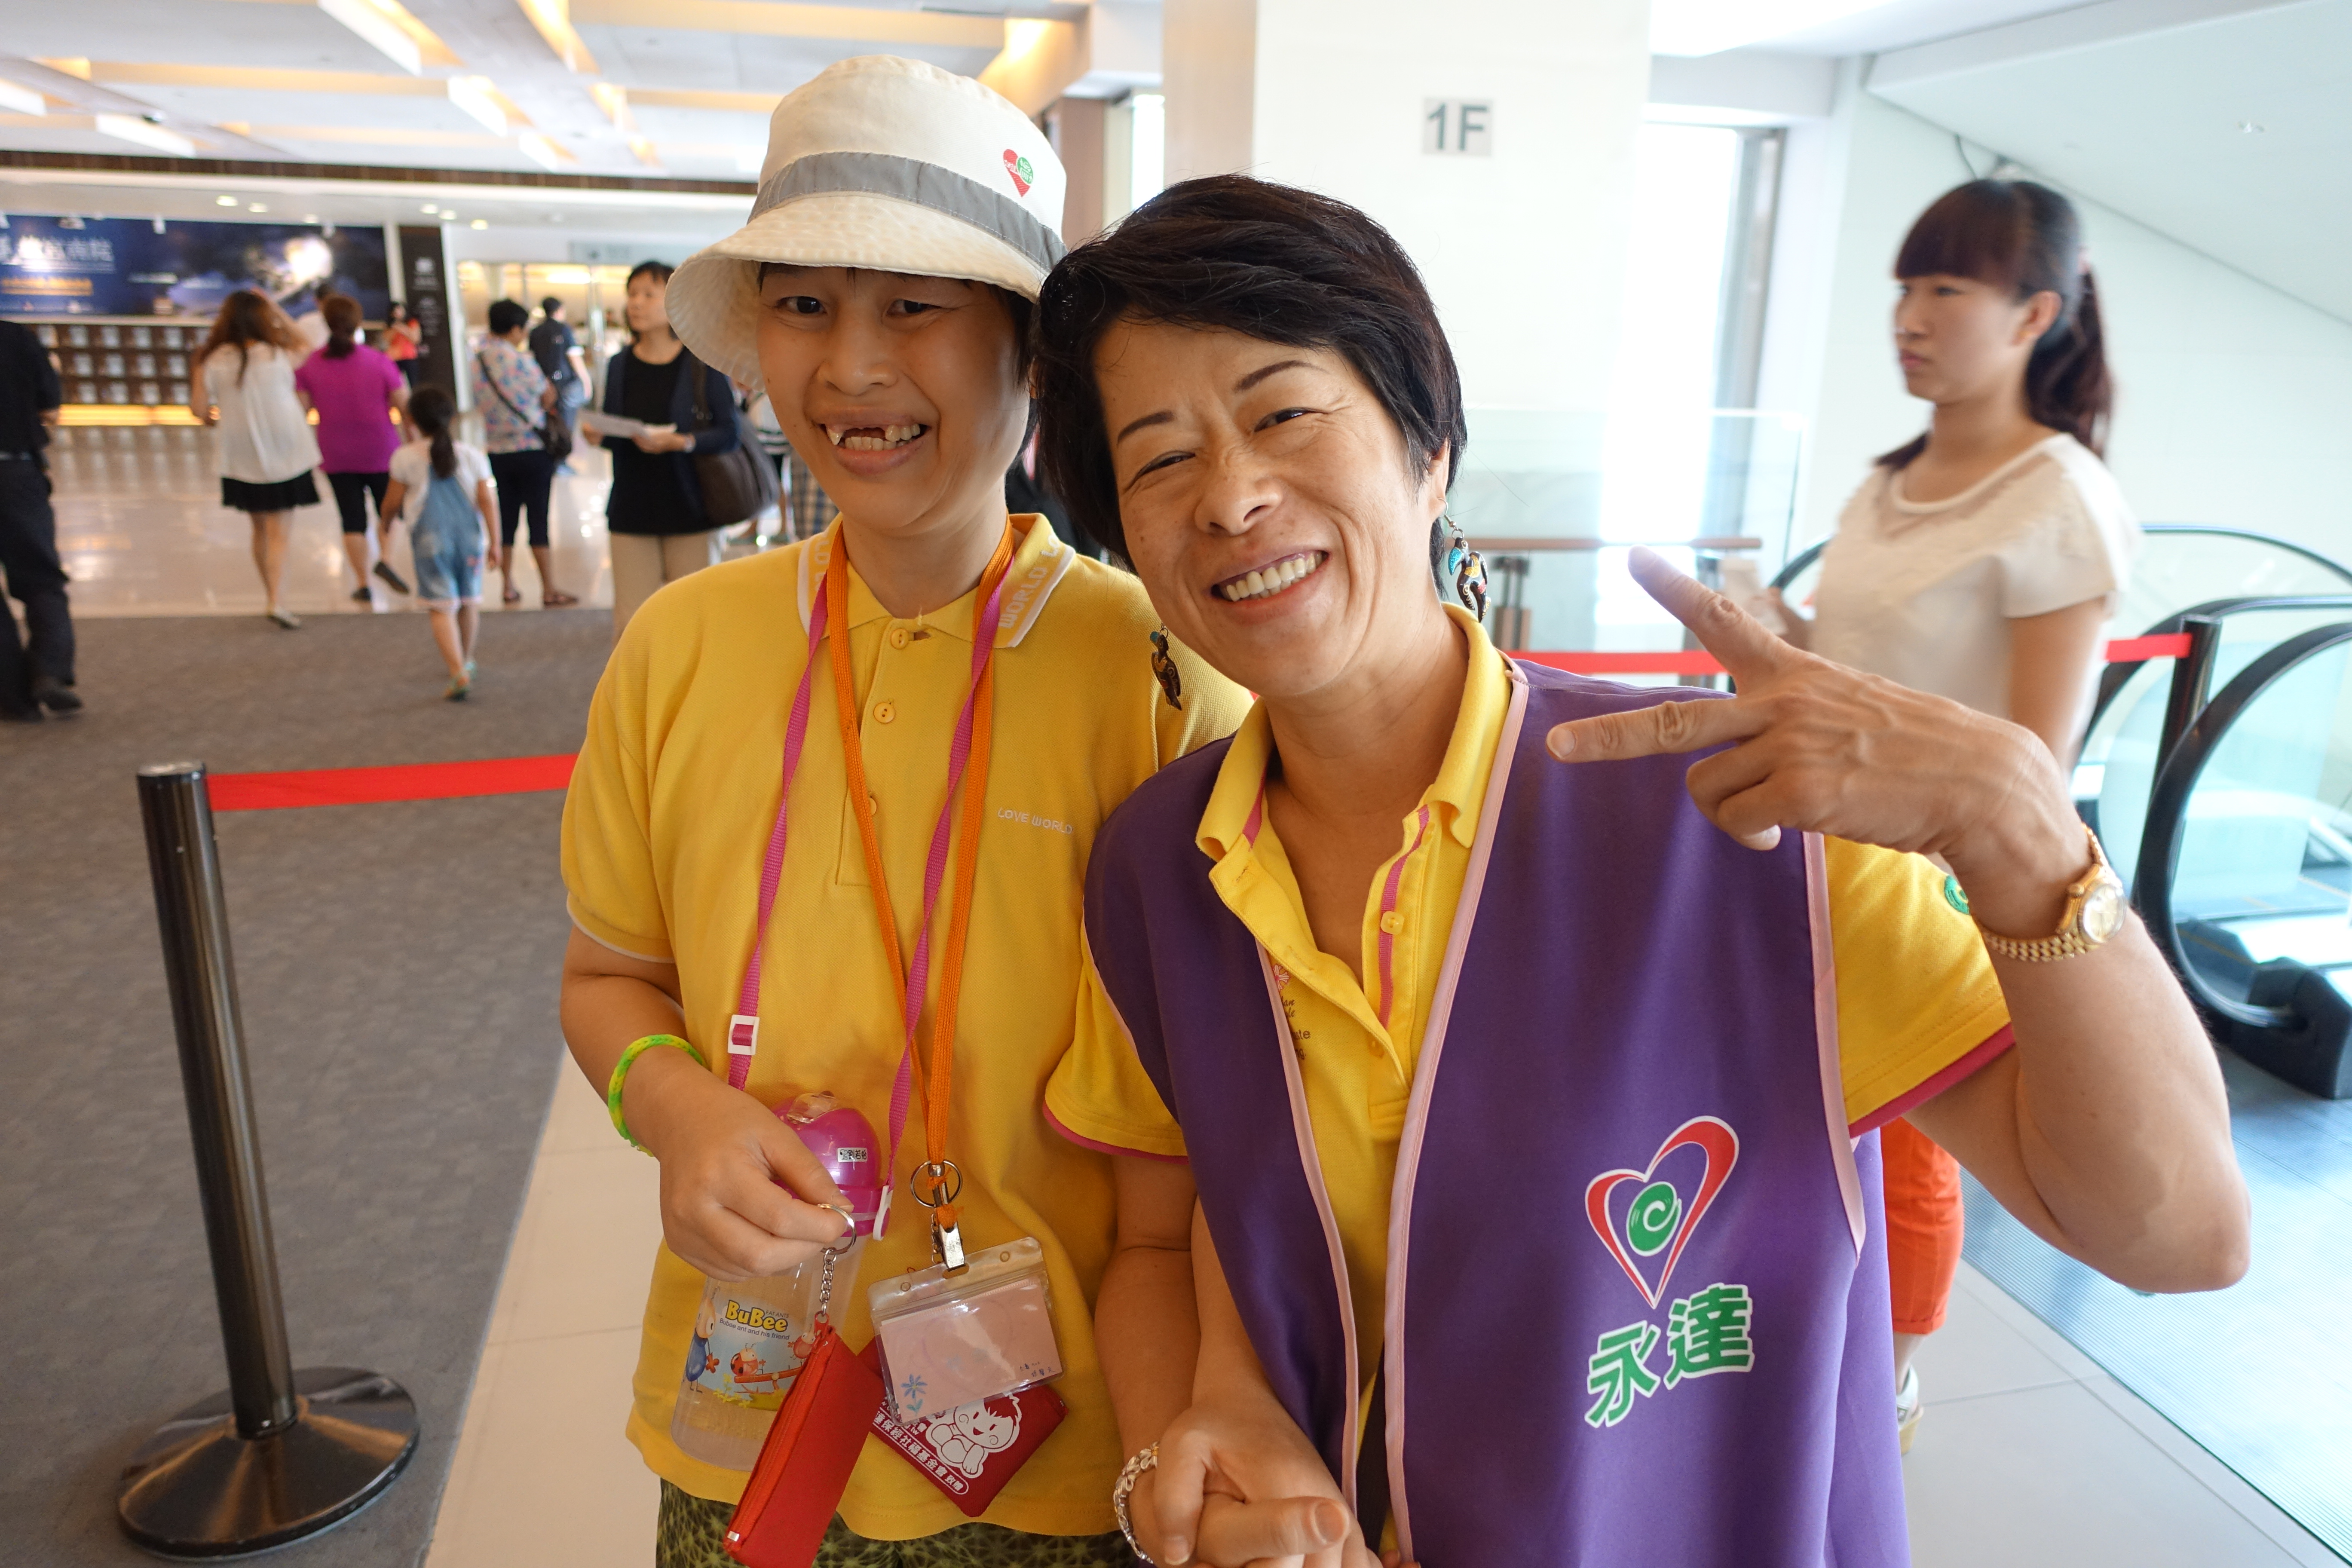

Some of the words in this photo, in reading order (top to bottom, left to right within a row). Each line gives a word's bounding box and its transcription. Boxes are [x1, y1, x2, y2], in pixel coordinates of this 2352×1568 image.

[1427, 102, 1489, 151] 1F
[998, 567, 1048, 628] WORLD
[997, 807, 1029, 823] LOVE
[1032, 815, 1073, 834] WORLD
[720, 1318, 736, 1329] Bubee
[771, 1332, 790, 1340] friend
[725, 1299, 788, 1332] BuBee
[1584, 1282, 1755, 1429] 永達
